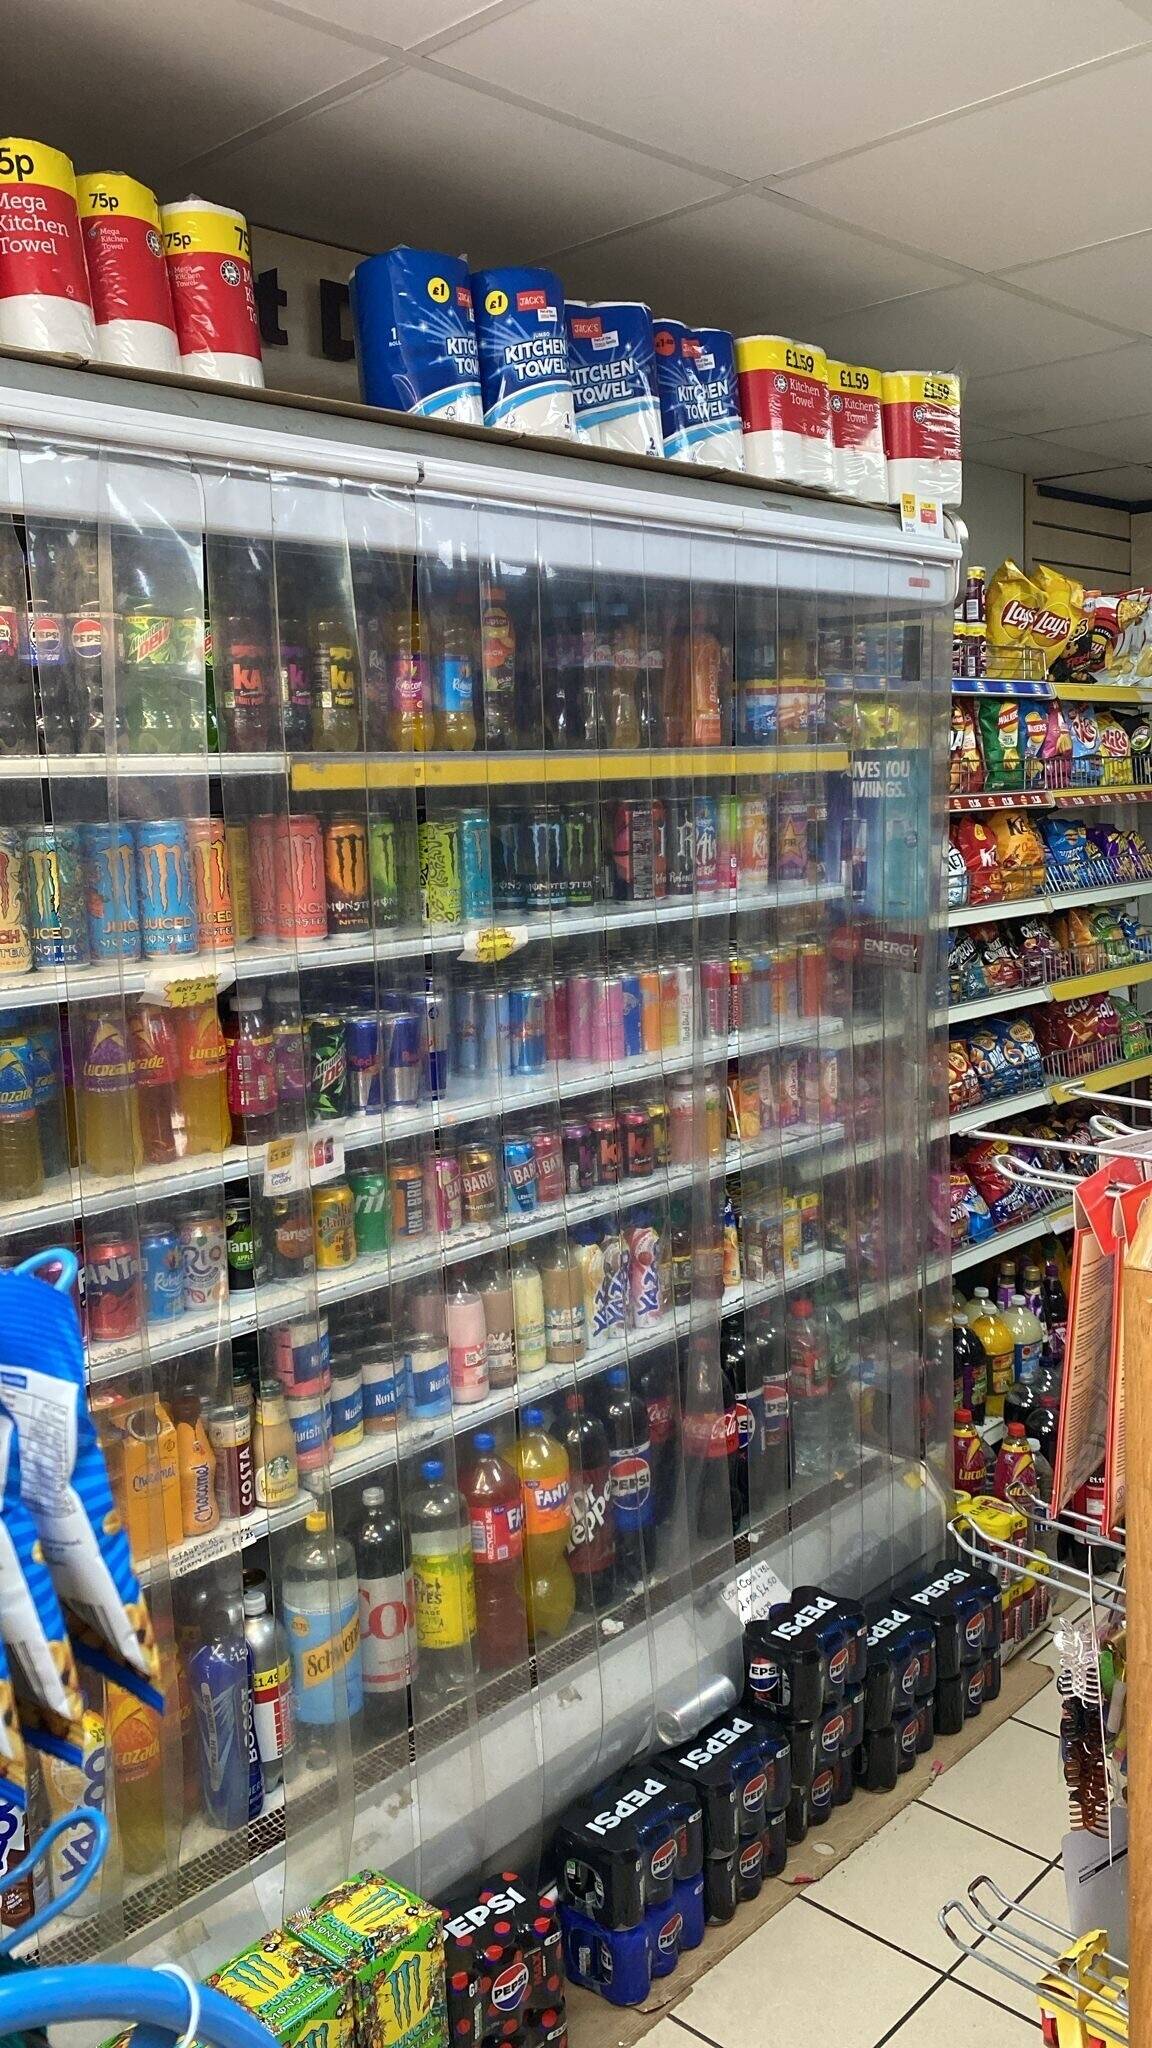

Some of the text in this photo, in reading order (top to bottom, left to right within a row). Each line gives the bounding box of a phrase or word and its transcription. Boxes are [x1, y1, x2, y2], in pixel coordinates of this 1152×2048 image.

[89, 193, 120, 216] 75p
[101, 227, 121, 238] Mega
[101, 234, 129, 246] Kitchen
[165, 232, 192, 250] 75p
[1, 237, 57, 256] Towel
[102, 243, 125, 252] Towel
[432, 283, 446, 301] £1
[519, 294, 545, 309] JACK'S
[489, 295, 503, 314] £1
[573, 321, 600, 338] JACK'S
[504, 338, 567, 368] KITCHEN
[785, 347, 815, 374] £1.59
[514, 356, 567, 383] TOWEL
[570, 358, 634, 387] KITCHEN
[840, 369, 870, 390] £1.59
[573, 379, 634, 407] TOWEL
[678, 379, 729, 403] KITCHEN
[789, 376, 821, 399] Kitchen
[685, 400, 728, 422] TOWEL
[790, 393, 815, 409] Towel
[844, 396, 875, 414] Kitchen
[845, 410, 869, 424] Towel
[650, 437, 656, 450] 2
[1033, 610, 1071, 639] Lay's
[884, 761, 910, 778] YOU
[144, 916, 193, 932] JUICED
[863, 938, 918, 959] ENERGY
[195, 983, 202, 991] 2
[83, 1059, 137, 1077] Lucozade
[462, 1170, 495, 1192] BARR
[77, 1256, 145, 1295] FANTA
[240, 1446, 252, 1506] COSTA
[610, 1474, 651, 1492] PEPSI
[191, 1462, 212, 1523] Chocomel
[910, 1567, 971, 1607] PEPSI
[770, 1595, 838, 1642] PEPSI
[678, 1717, 754, 1771] PEPSI
[585, 1778, 667, 1836] PEPSI
[310, 1920, 355, 1953] MONSTER
[322, 1914, 367, 1946] PUNCH
[382, 1933, 420, 1964] RIO PUNCH
[260, 1973, 313, 2015] PUNCH
[494, 1973, 528, 2000] PEPSI
[267, 1982, 326, 2023] MONSTER
[289, 2001, 329, 2036] RIO PUNCH
